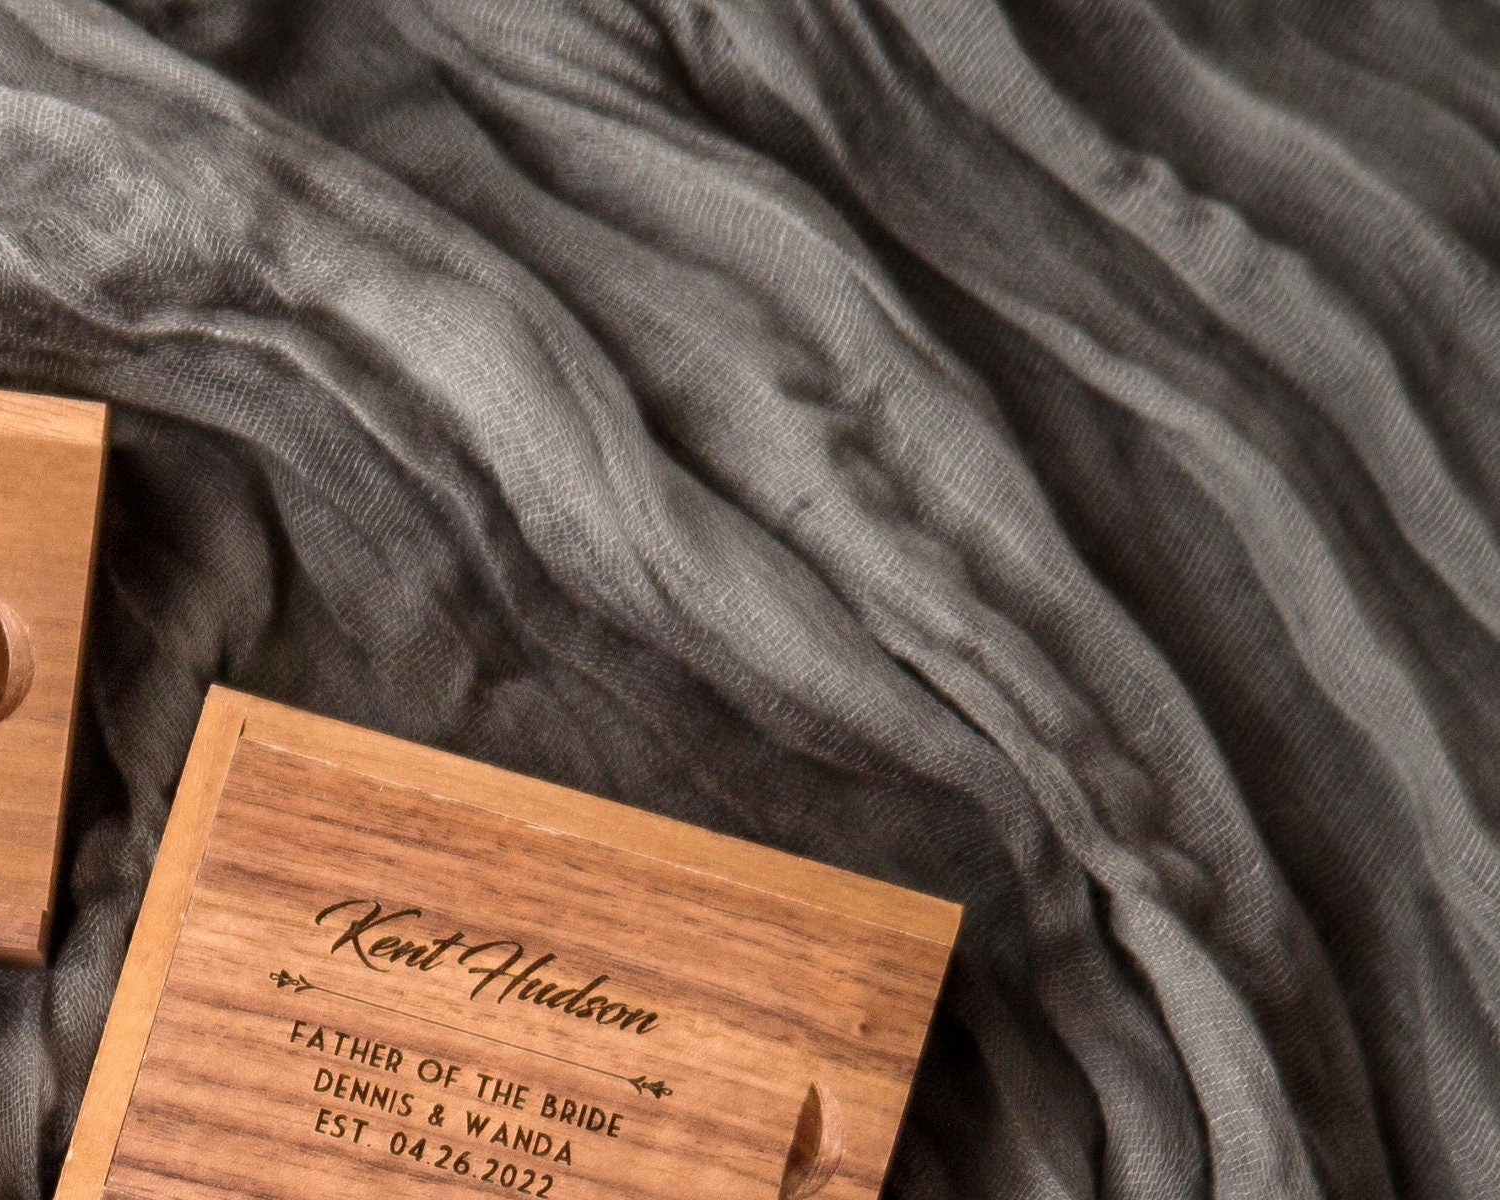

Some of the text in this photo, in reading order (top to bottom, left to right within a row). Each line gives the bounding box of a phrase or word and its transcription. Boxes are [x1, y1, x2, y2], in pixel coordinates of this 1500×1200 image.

[314, 899, 660, 1036] Kent Hudson
[289, 1019, 624, 1139] FATHER OF THE BRIDE
[312, 1067, 573, 1167] DENNIS & WANDA
[314, 1108, 554, 1200] EST. 04.26.2022
